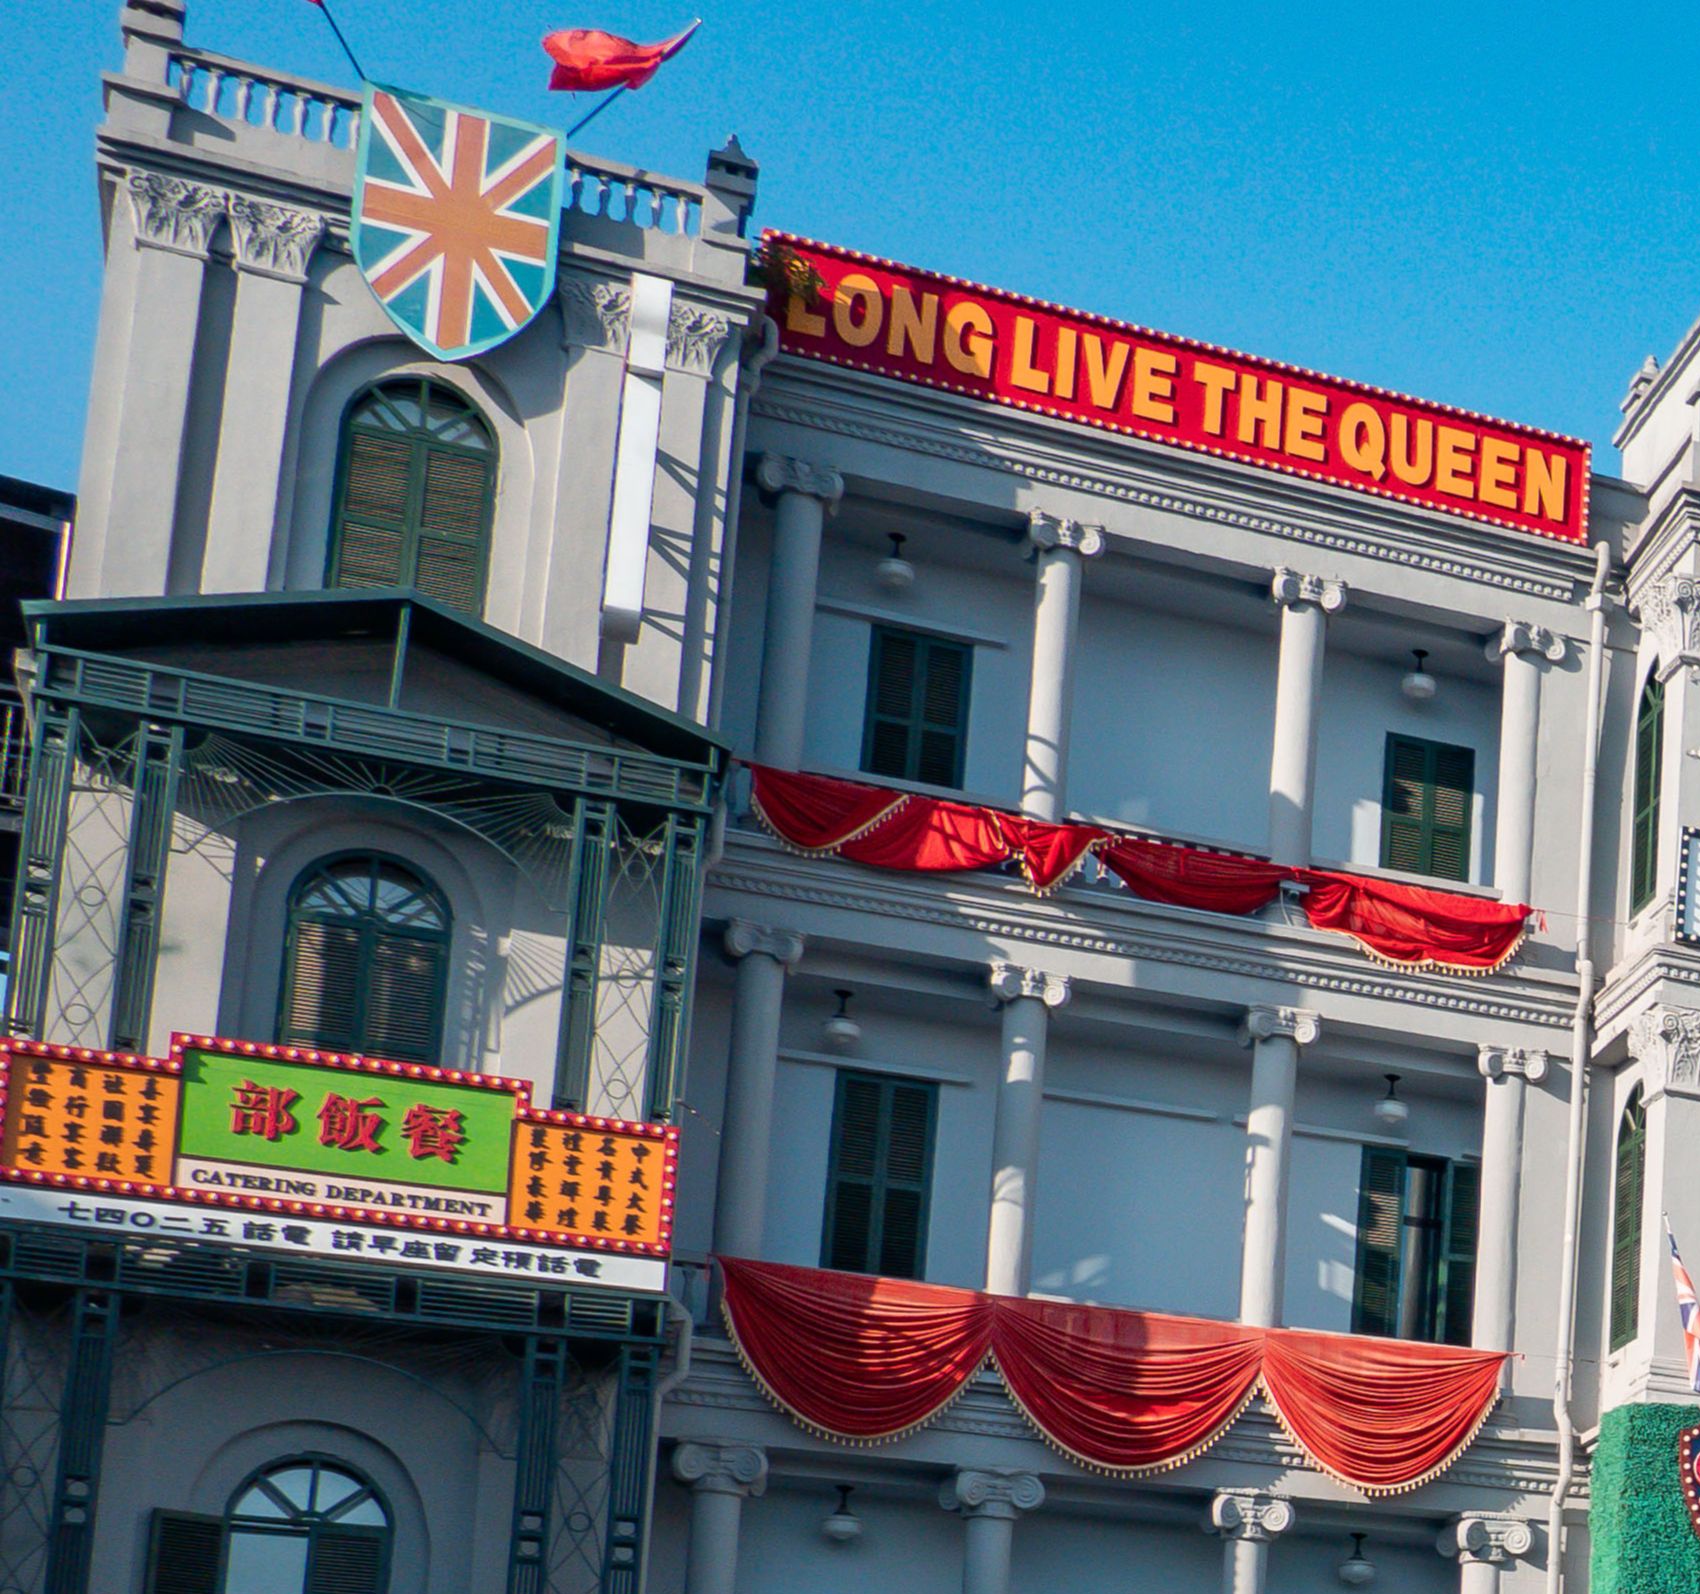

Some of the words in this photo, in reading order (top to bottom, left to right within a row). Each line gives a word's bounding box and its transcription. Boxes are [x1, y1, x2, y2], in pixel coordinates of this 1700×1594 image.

[786, 272, 994, 379] LONG
[1011, 317, 1178, 421] LIVE
[1194, 362, 1329, 460] THE
[1338, 402, 1568, 523] QUEEN
[191, 1168, 317, 1201] CATERING
[325, 1184, 491, 1217] DEPARTMENT
